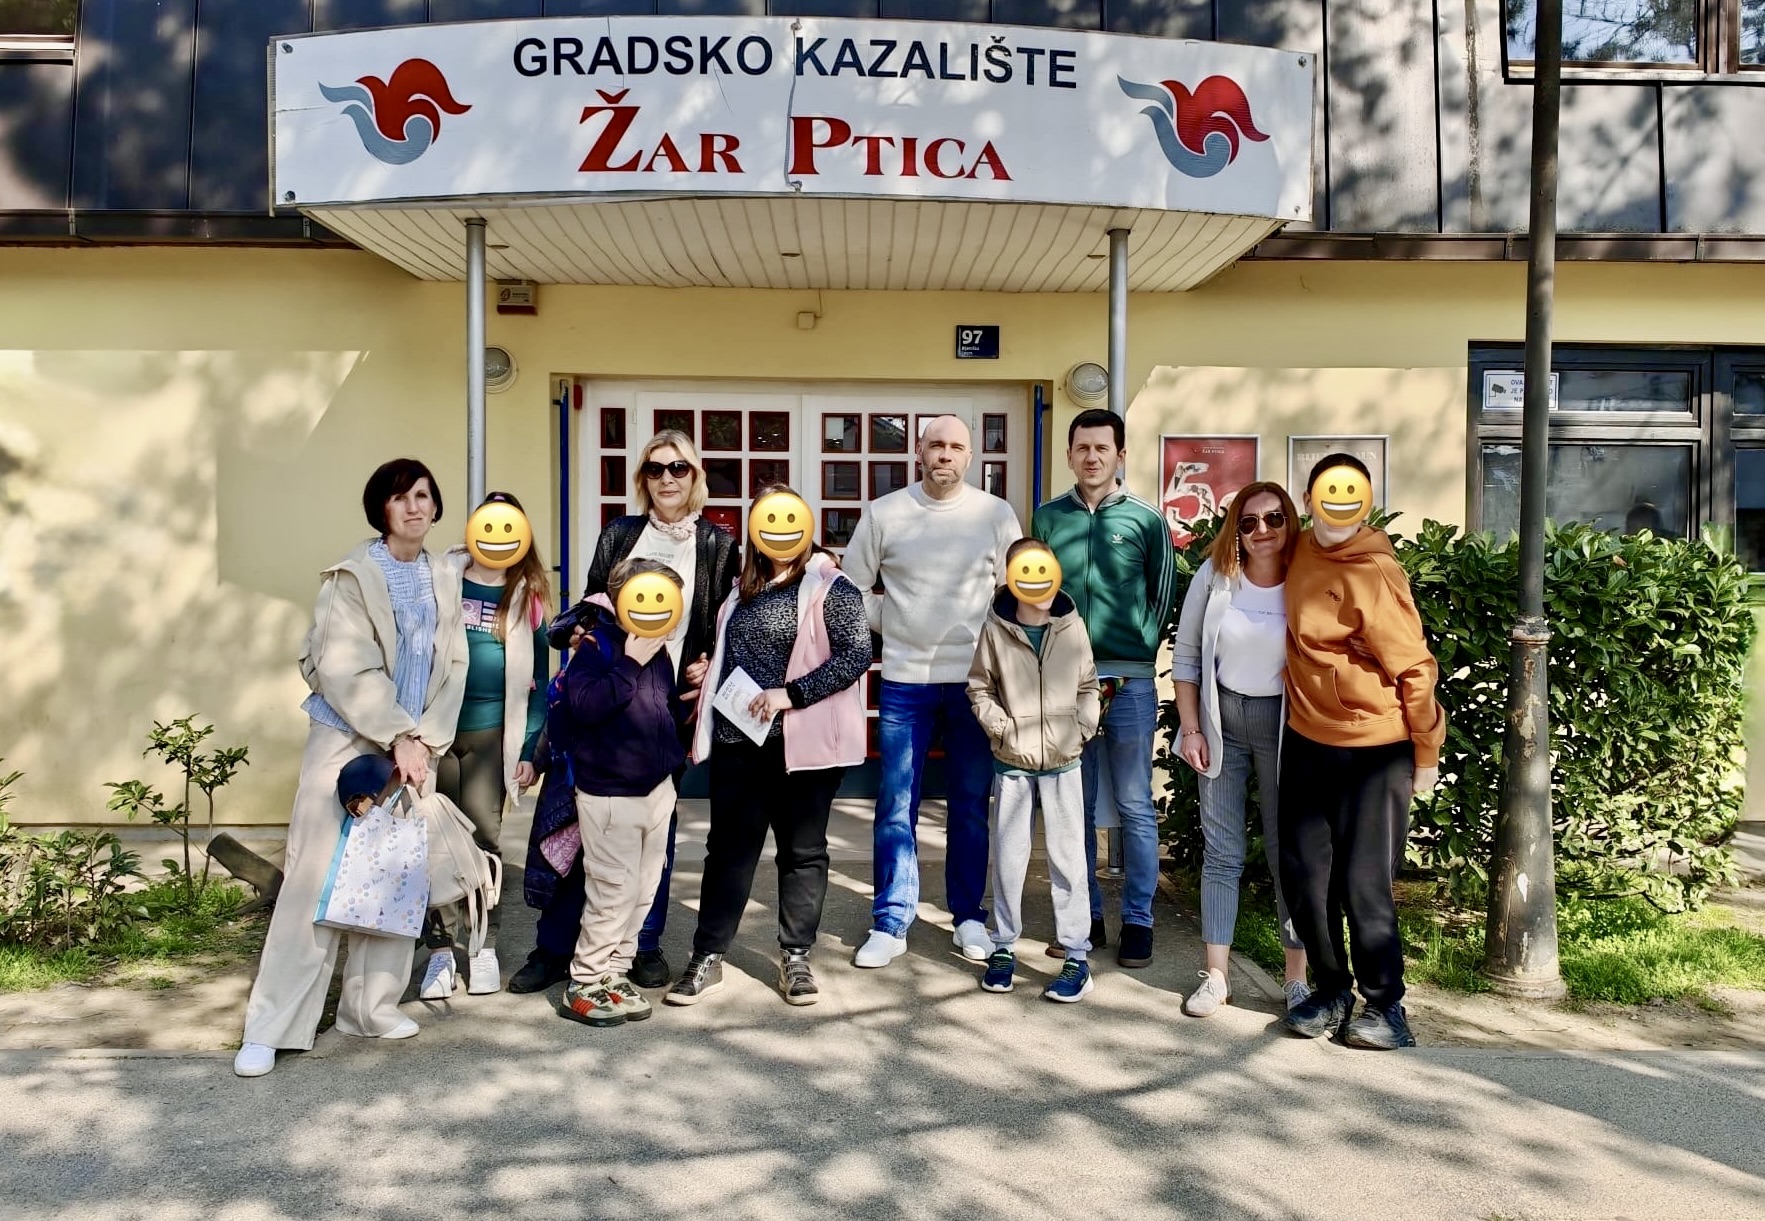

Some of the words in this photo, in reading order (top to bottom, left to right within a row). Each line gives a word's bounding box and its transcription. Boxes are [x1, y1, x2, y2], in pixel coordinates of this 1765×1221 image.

[513, 36, 773, 77] GRADSKO
[796, 35, 1077, 88] KAZALIŠTE
[578, 88, 747, 173] ŽAR
[962, 330, 983, 344] 97
